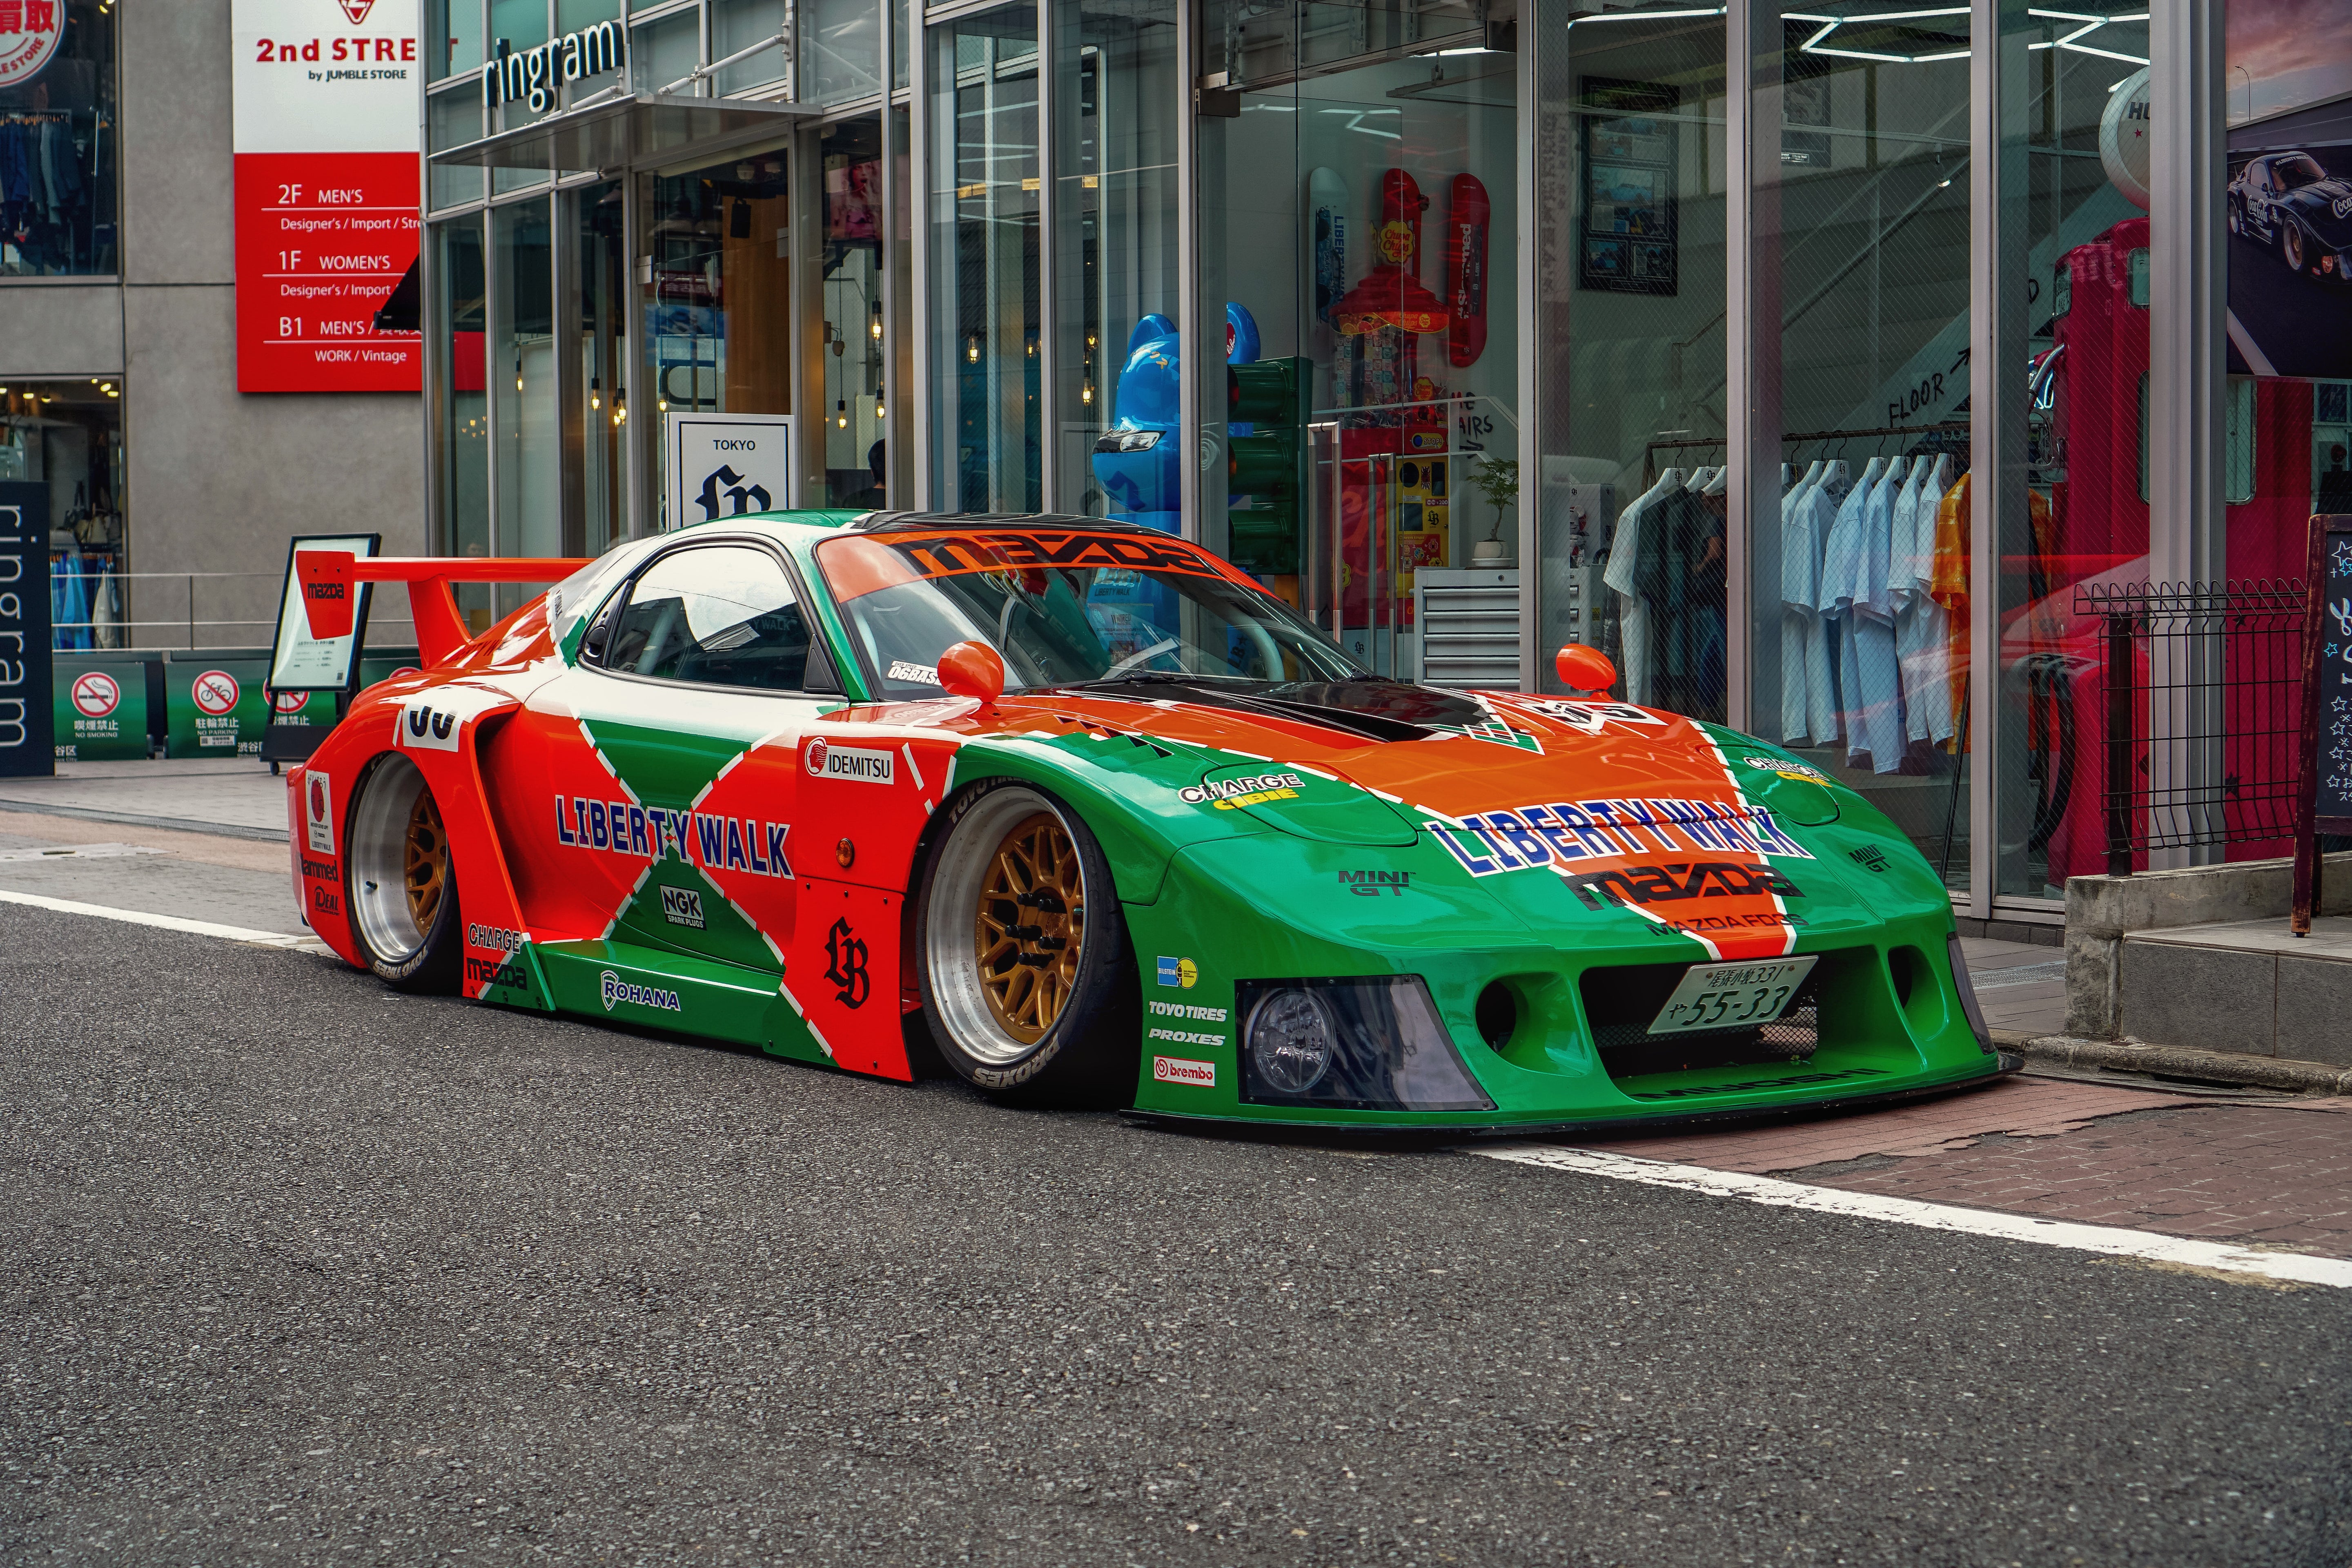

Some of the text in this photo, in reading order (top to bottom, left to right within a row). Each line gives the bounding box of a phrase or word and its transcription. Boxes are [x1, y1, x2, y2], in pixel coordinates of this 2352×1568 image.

[10, 37, 45, 71] STORE
[256, 38, 319, 62] 2nd
[309, 69, 406, 82] by JUMBLE STORE
[482, 20, 625, 112] ringram
[278, 184, 363, 205] 2F MEN'S
[281, 217, 341, 233] Designer's
[352, 217, 391, 232] Import
[279, 250, 391, 271] 1F WOMEN'S
[281, 284, 341, 299] Designer's
[351, 283, 391, 298] Import
[280, 317, 302, 337] B1
[320, 321, 365, 336] MEN'S
[315, 350, 352, 363] WORK
[362, 350, 407, 365] Vintage
[1889, 372, 1944, 428] FLOOR
[713, 439, 756, 450] TOKYO
[307, 583, 345, 599] mazda
[0, 505, 37, 747] ringram
[237, 741, 264, 753] 渋谷
[829, 754, 890, 779] IDEMITSU
[1178, 773, 1306, 804] CHARGE
[1214, 788, 1300, 811] CIBIE
[555, 794, 795, 880] LIBERTY WALK
[1423, 798, 1817, 878] LIBERTY WALK
[1848, 844, 1883, 862] MINI
[1865, 855, 1892, 873] GT
[1338, 871, 1410, 884] MINI
[1559, 862, 1806, 911] mazda
[1350, 883, 1410, 897] GT
[661, 887, 704, 919] NGK
[668, 915, 704, 929] SPARK PLUGS
[1645, 913, 1810, 937] MAZDA FD3S
[468, 922, 523, 954] CHARGE
[372, 945, 429, 979] TOYO TIRES
[466, 957, 528, 990] mazda
[604, 978, 681, 1011] ROHANA
[1669, 984, 1791, 1026] や 55-33
[1149, 1001, 1227, 1022] TOYO TIRES
[1148, 1028, 1226, 1046] PROXES
[972, 1031, 1061, 1089] PROXES
[1169, 1062, 1213, 1081] brembo
[1628, 1068, 1895, 1099] MIYOSHI
